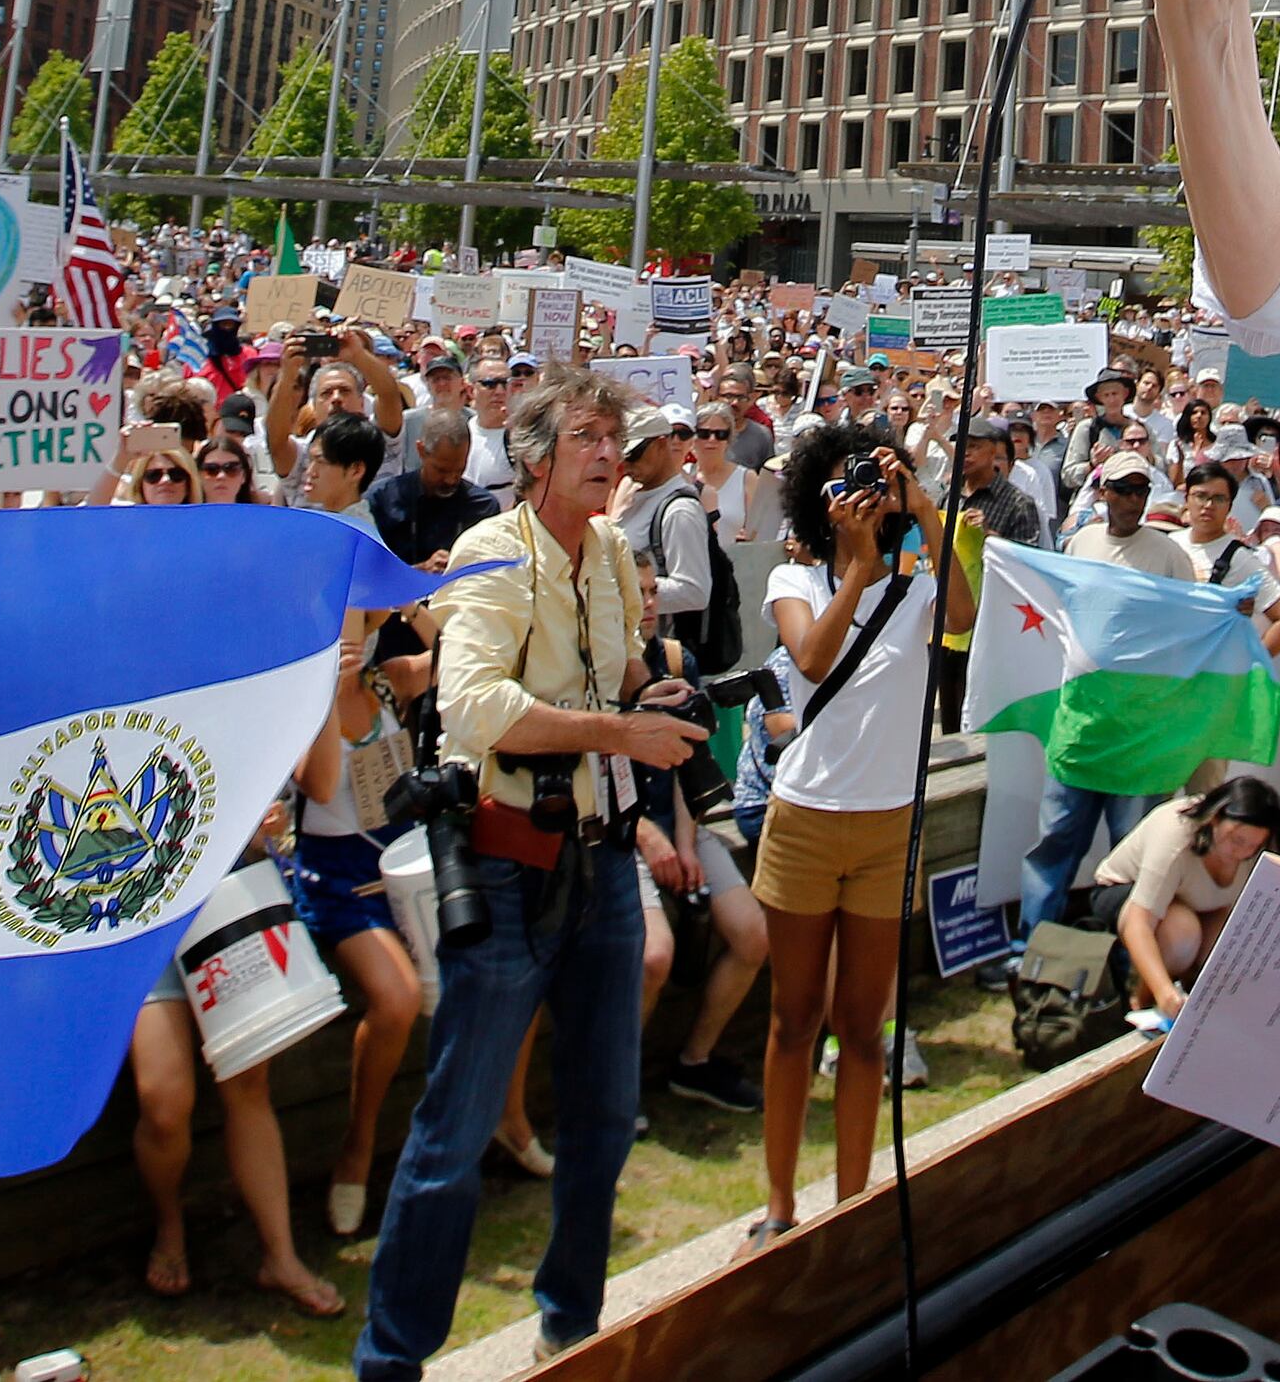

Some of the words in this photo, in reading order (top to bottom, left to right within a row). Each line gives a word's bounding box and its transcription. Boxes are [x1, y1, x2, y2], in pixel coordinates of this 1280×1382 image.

[772, 193, 811, 212] PLAZA
[267, 279, 298, 300] NO
[347, 273, 412, 303] ABOLISH
[541, 292, 576, 301] REUNITE
[255, 302, 302, 323] ICE
[355, 297, 390, 319] ICE
[437, 304, 492, 319] TORTURE
[538, 302, 574, 311] FAMILIES
[543, 312, 570, 323] NOW
[9, 711, 117, 797] SALVADOR
[122, 709, 154, 731] EN
[153, 715, 183, 744] LA
[177, 735, 218, 827] AMERICA
